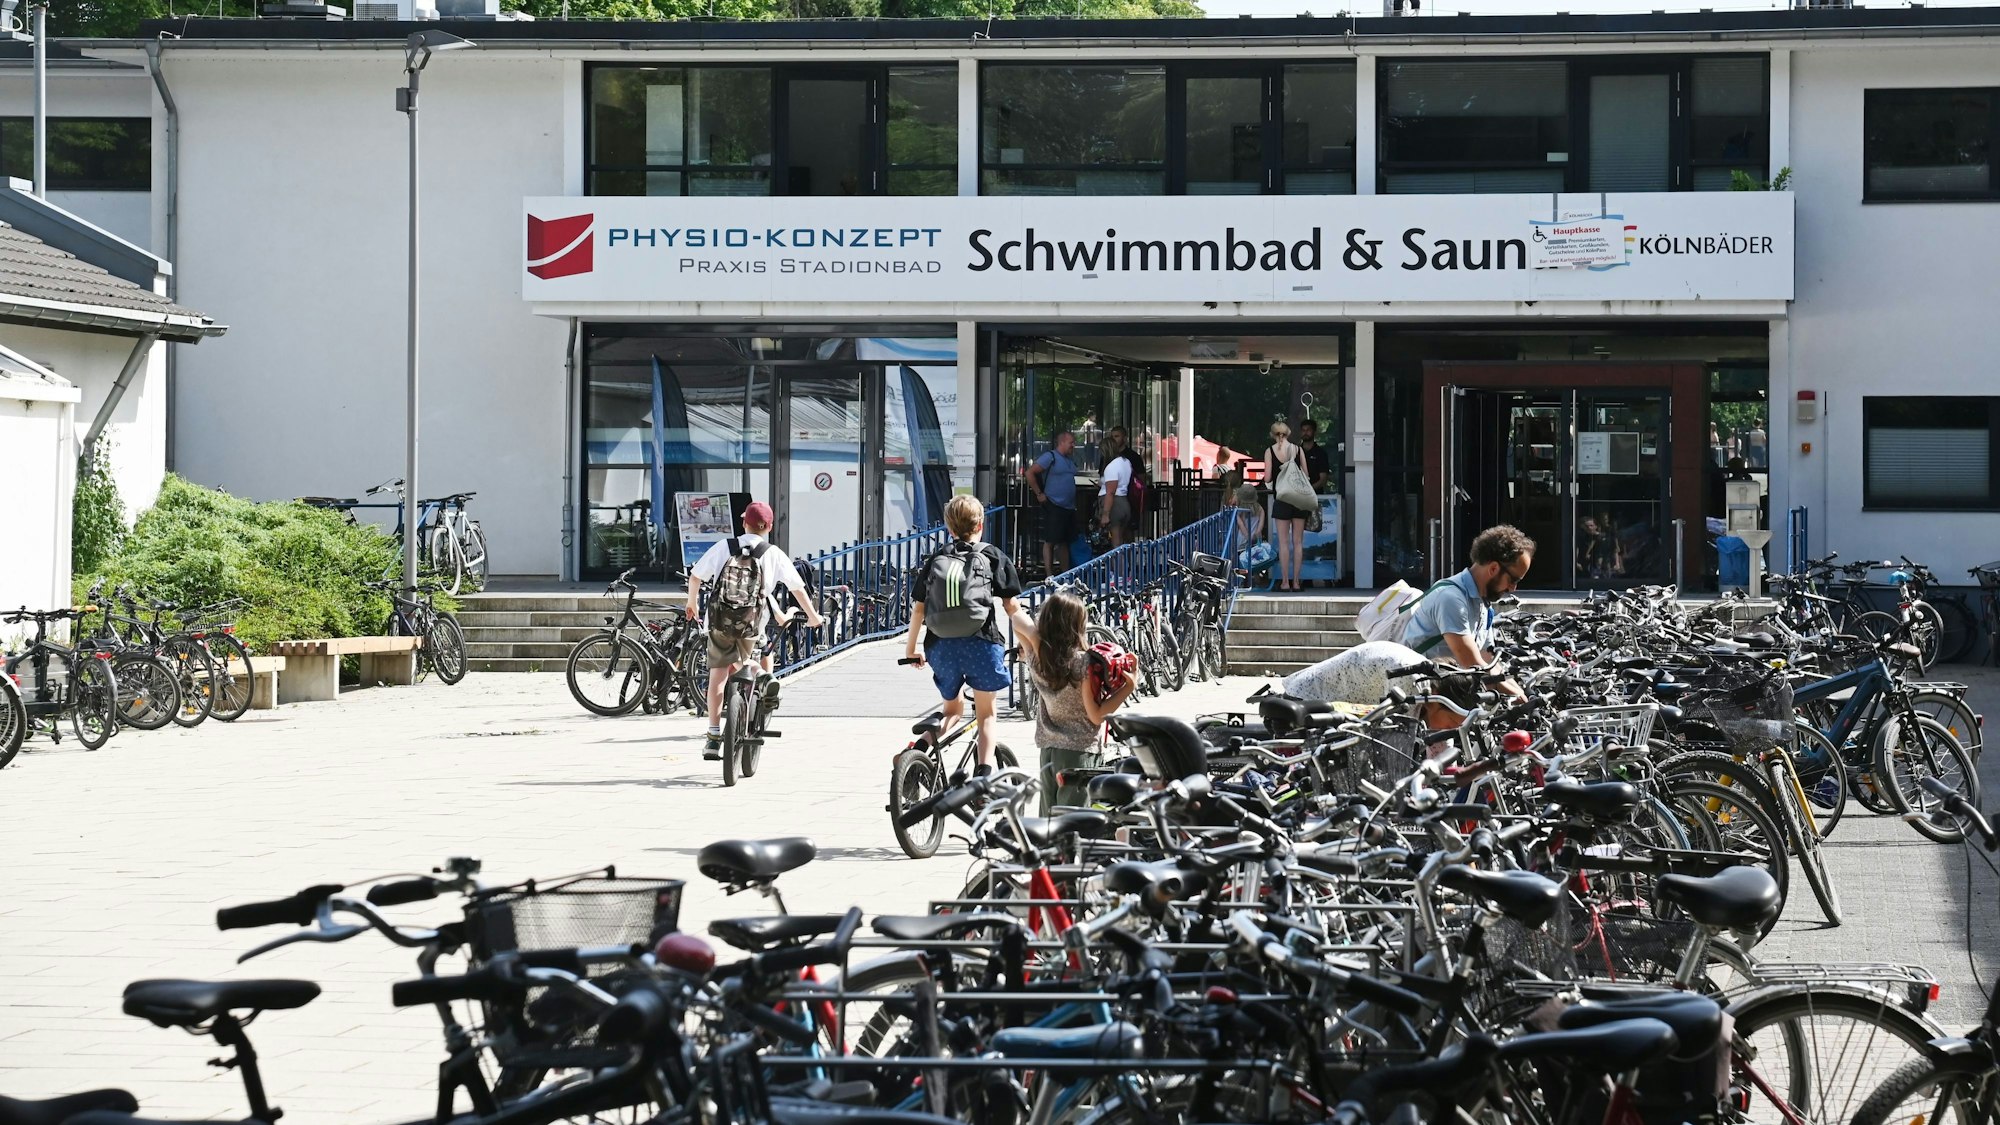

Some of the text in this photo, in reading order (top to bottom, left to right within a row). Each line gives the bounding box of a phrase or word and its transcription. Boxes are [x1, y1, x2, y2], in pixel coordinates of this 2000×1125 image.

[608, 228, 942, 248] PHYSIO-KONZEPT
[1553, 227, 1601, 235] Hauptkasse
[967, 226, 1558, 272] Schwimmbad & Saun
[1639, 233, 1774, 256] KÖLNBÄDER
